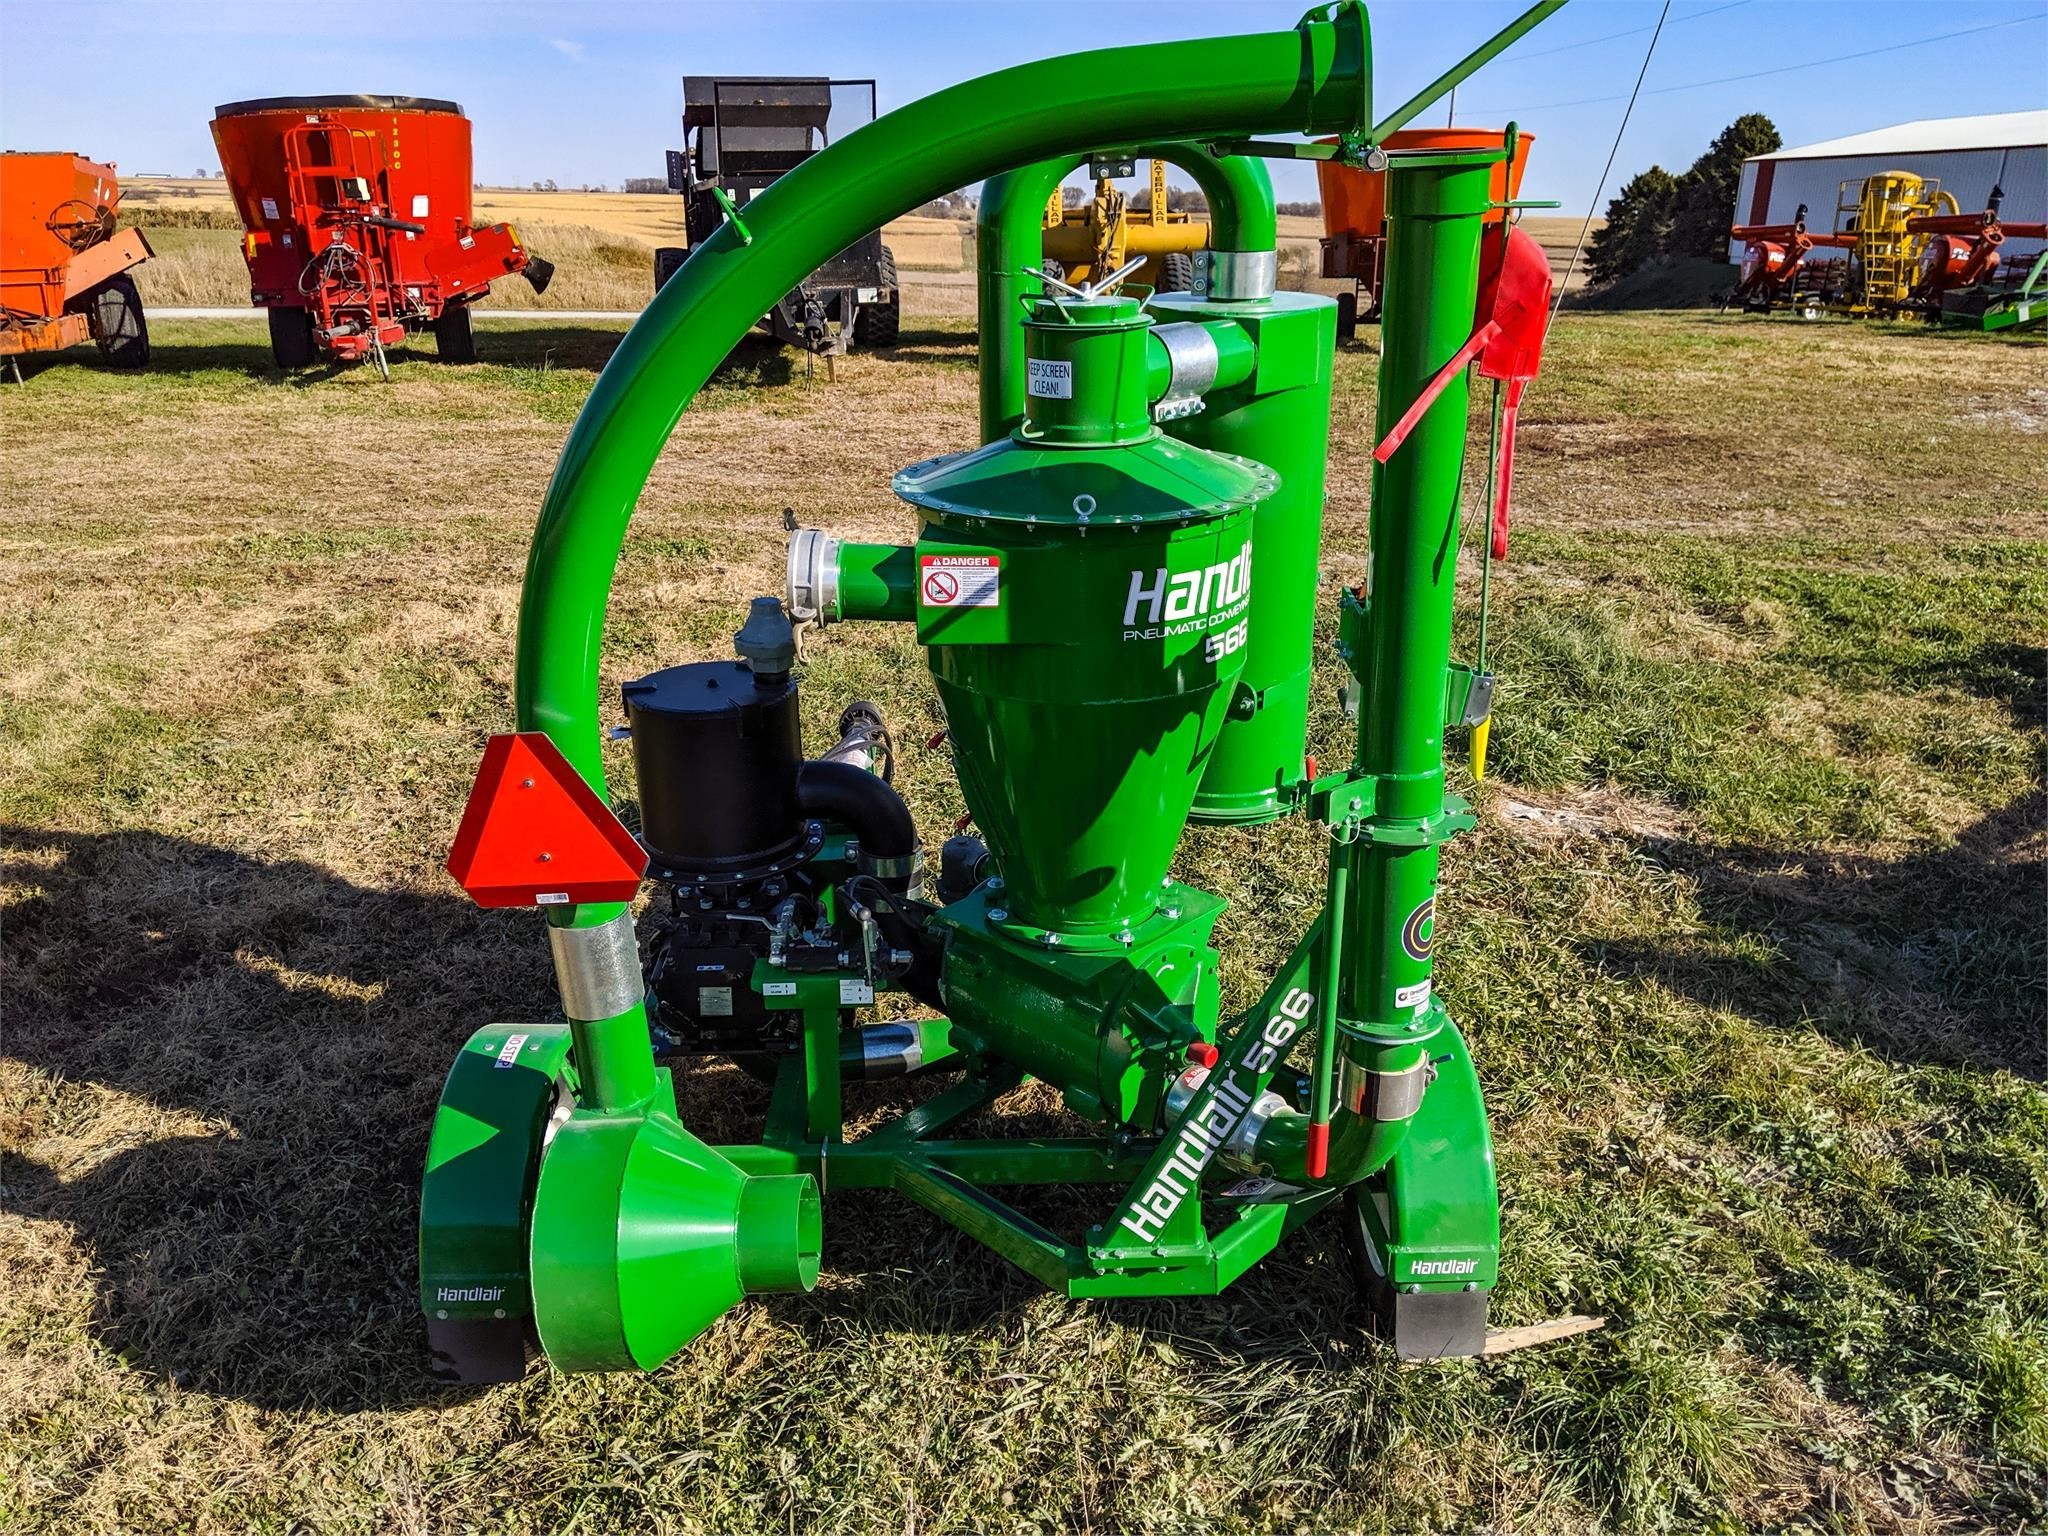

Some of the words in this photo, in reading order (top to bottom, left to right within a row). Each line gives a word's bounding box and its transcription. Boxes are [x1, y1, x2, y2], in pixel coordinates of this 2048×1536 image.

[1029, 362, 1040, 376] EEP
[1042, 363, 1070, 379] SCREEN
[1035, 380, 1059, 396] CLEAN!
[942, 557, 990, 566] DANGER
[1123, 539, 1252, 626] Handl
[1123, 618, 1207, 641] PNEUMATIC
[1205, 617, 1248, 664] 566
[499, 1046, 517, 1067] STEP
[1120, 1068, 1252, 1243] Handlair
[1241, 987, 1315, 1074] 566
[1411, 1258, 1479, 1275] Handlair
[437, 1286, 505, 1302] Handlair
